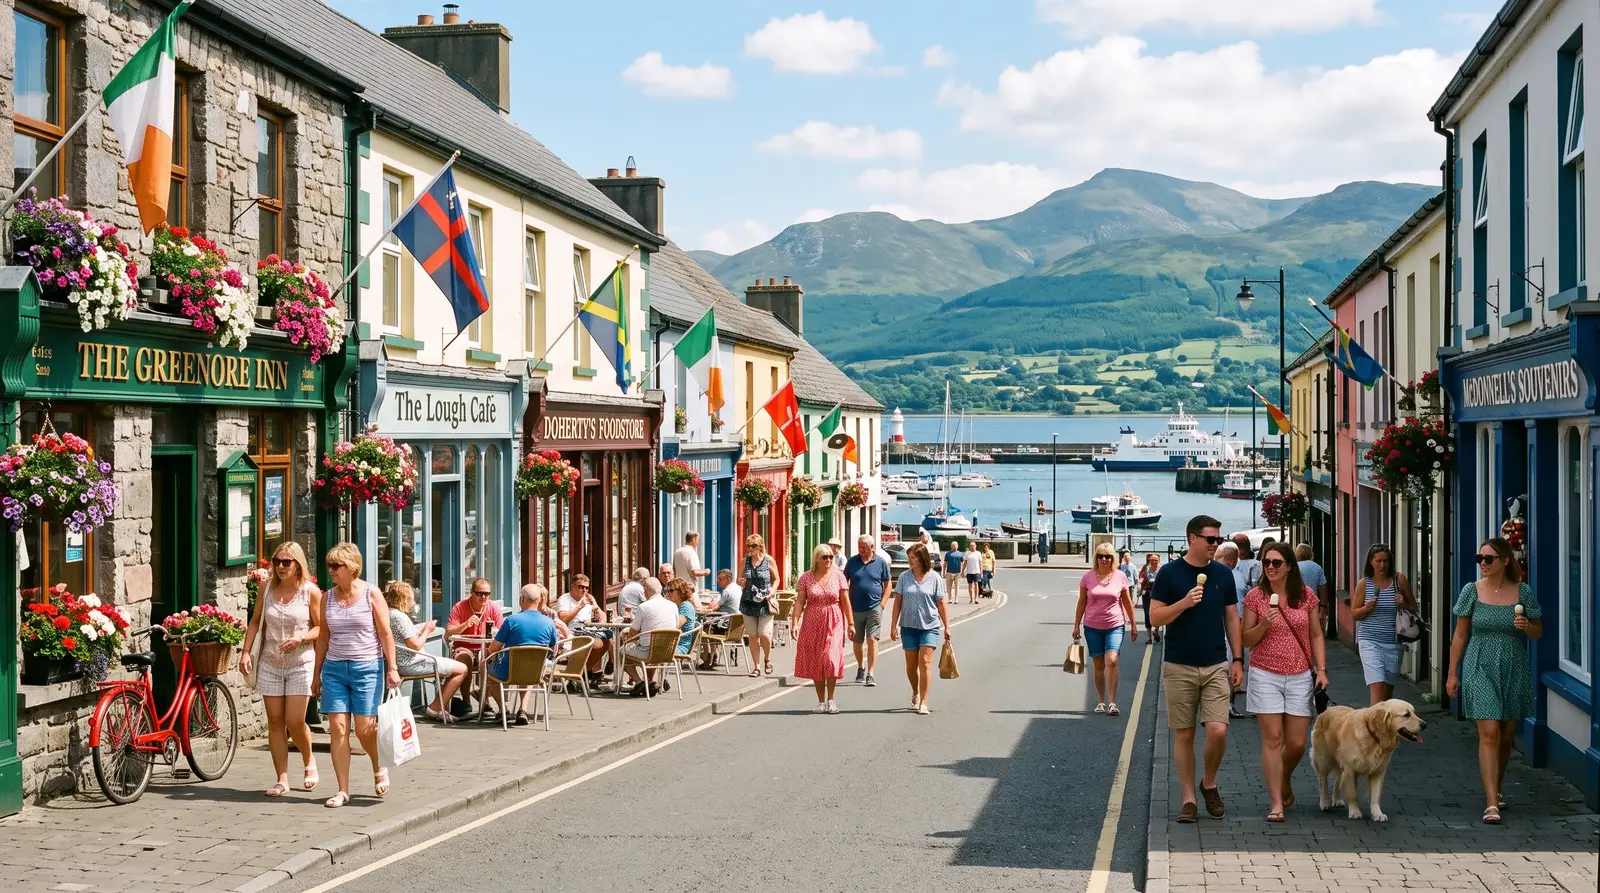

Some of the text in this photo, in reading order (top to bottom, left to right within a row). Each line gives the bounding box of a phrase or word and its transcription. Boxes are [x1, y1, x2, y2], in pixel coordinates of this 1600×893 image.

[78, 341, 289, 390] THE GREENORE INN
[1518, 359, 1579, 403] SOUVENIRS
[395, 391, 496, 429] The Lough Café
[543, 416, 644, 440] DOHERTY'S FOODSTORE
